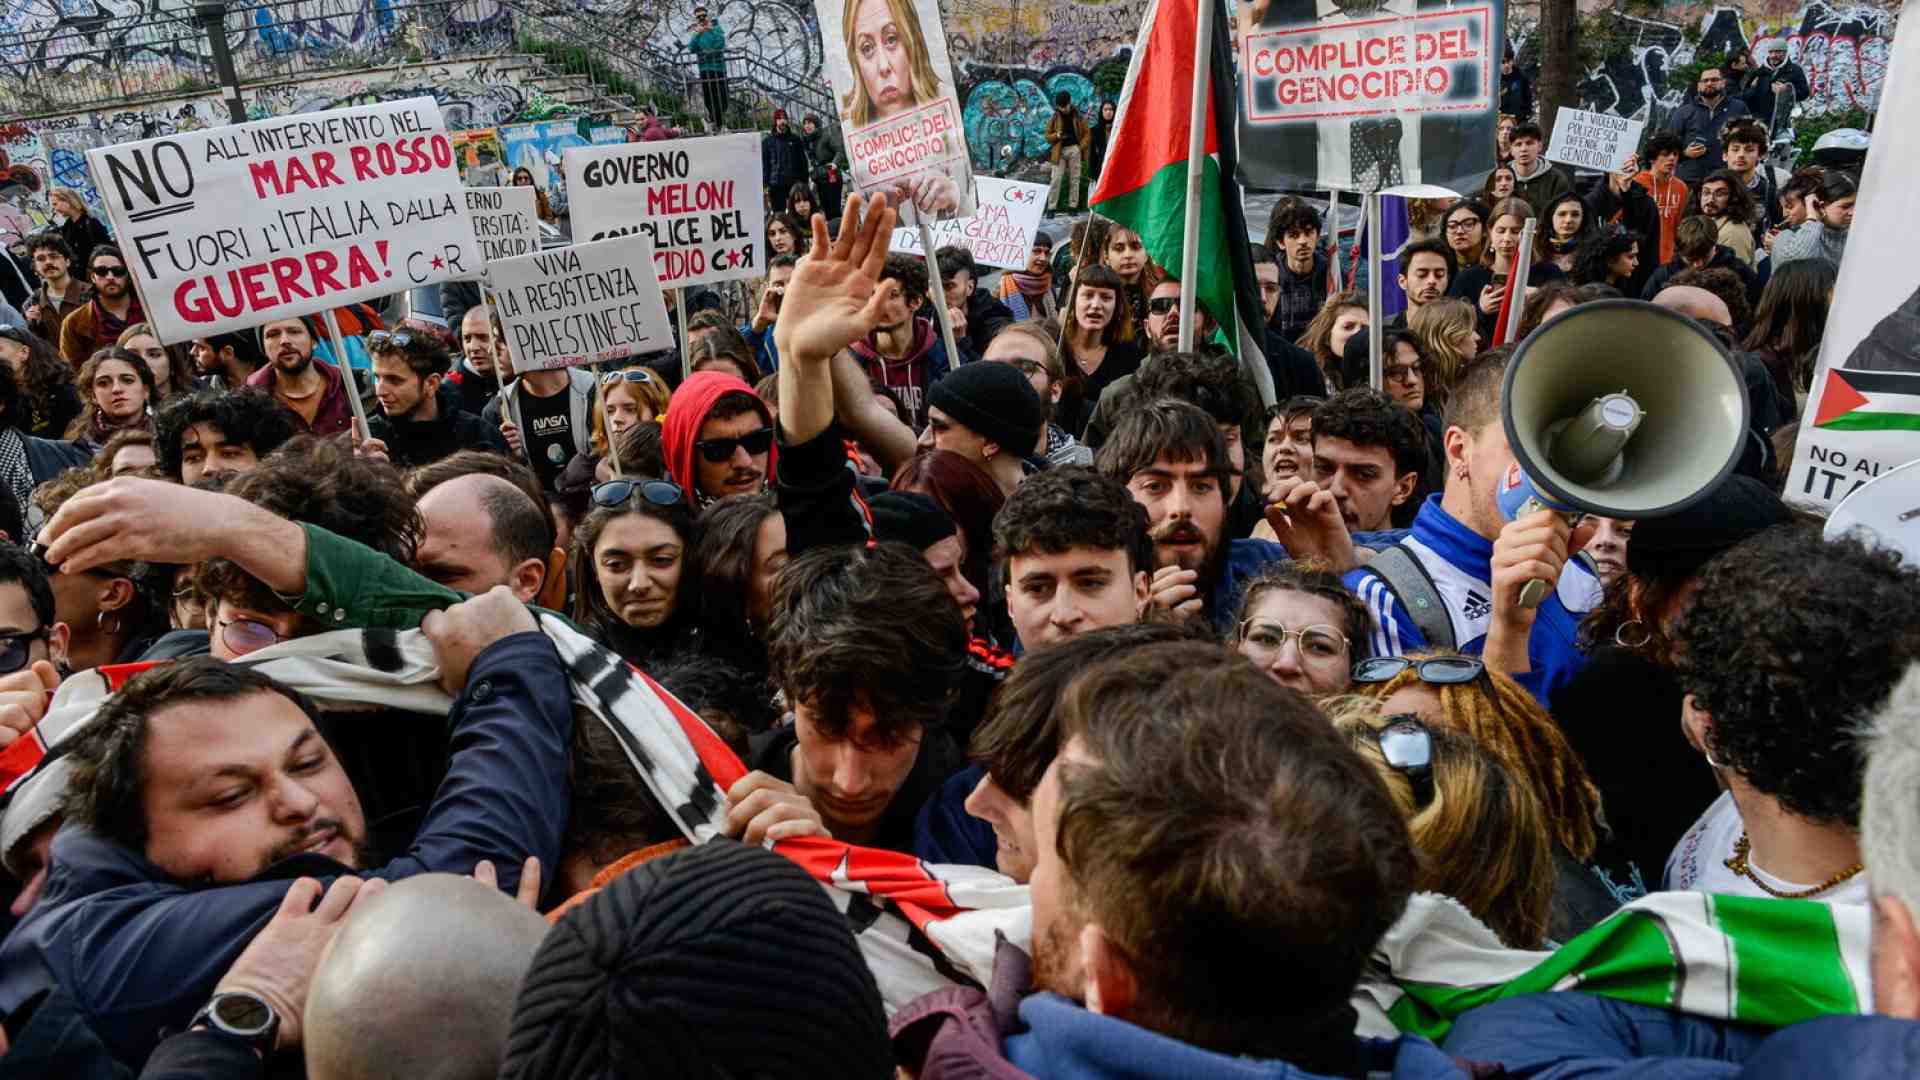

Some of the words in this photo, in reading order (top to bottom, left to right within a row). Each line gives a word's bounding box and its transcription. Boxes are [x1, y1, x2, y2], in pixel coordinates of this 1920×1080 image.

[1255, 35, 1408, 76] COMPLICE
[1415, 29, 1478, 62] DEL
[1278, 65, 1449, 105] GENOCIDIO
[206, 116, 385, 163] ALL'INTERVENTO
[391, 110, 432, 134] NEL
[854, 122, 918, 160] COMPLICE
[922, 111, 953, 137] DEL
[1567, 122, 1619, 142] POLIZIESCA
[1574, 111, 1584, 121] LA
[1590, 114, 1629, 133] VIOLENZA
[248, 150, 345, 200] MAR
[350, 133, 453, 181] ROSSO
[868, 137, 945, 176] GENOCIDIO
[1560, 146, 1613, 169] GENOCIDIO
[1604, 143, 1618, 153] UN
[104, 141, 194, 213] NO
[583, 150, 690, 188] GOVERNO
[647, 180, 735, 216] MELONI
[134, 229, 251, 281] FUORI
[390, 193, 457, 227] DALLA
[711, 210, 750, 242] DEL
[173, 240, 393, 323] GUERRA!
[534, 251, 582, 277] VIVA
[498, 291, 522, 319] LA
[524, 266, 640, 311] RESISTENZA
[513, 303, 650, 362] PALESTINESE
[532, 414, 568, 431] NASA
[1809, 445, 1848, 468] NO
